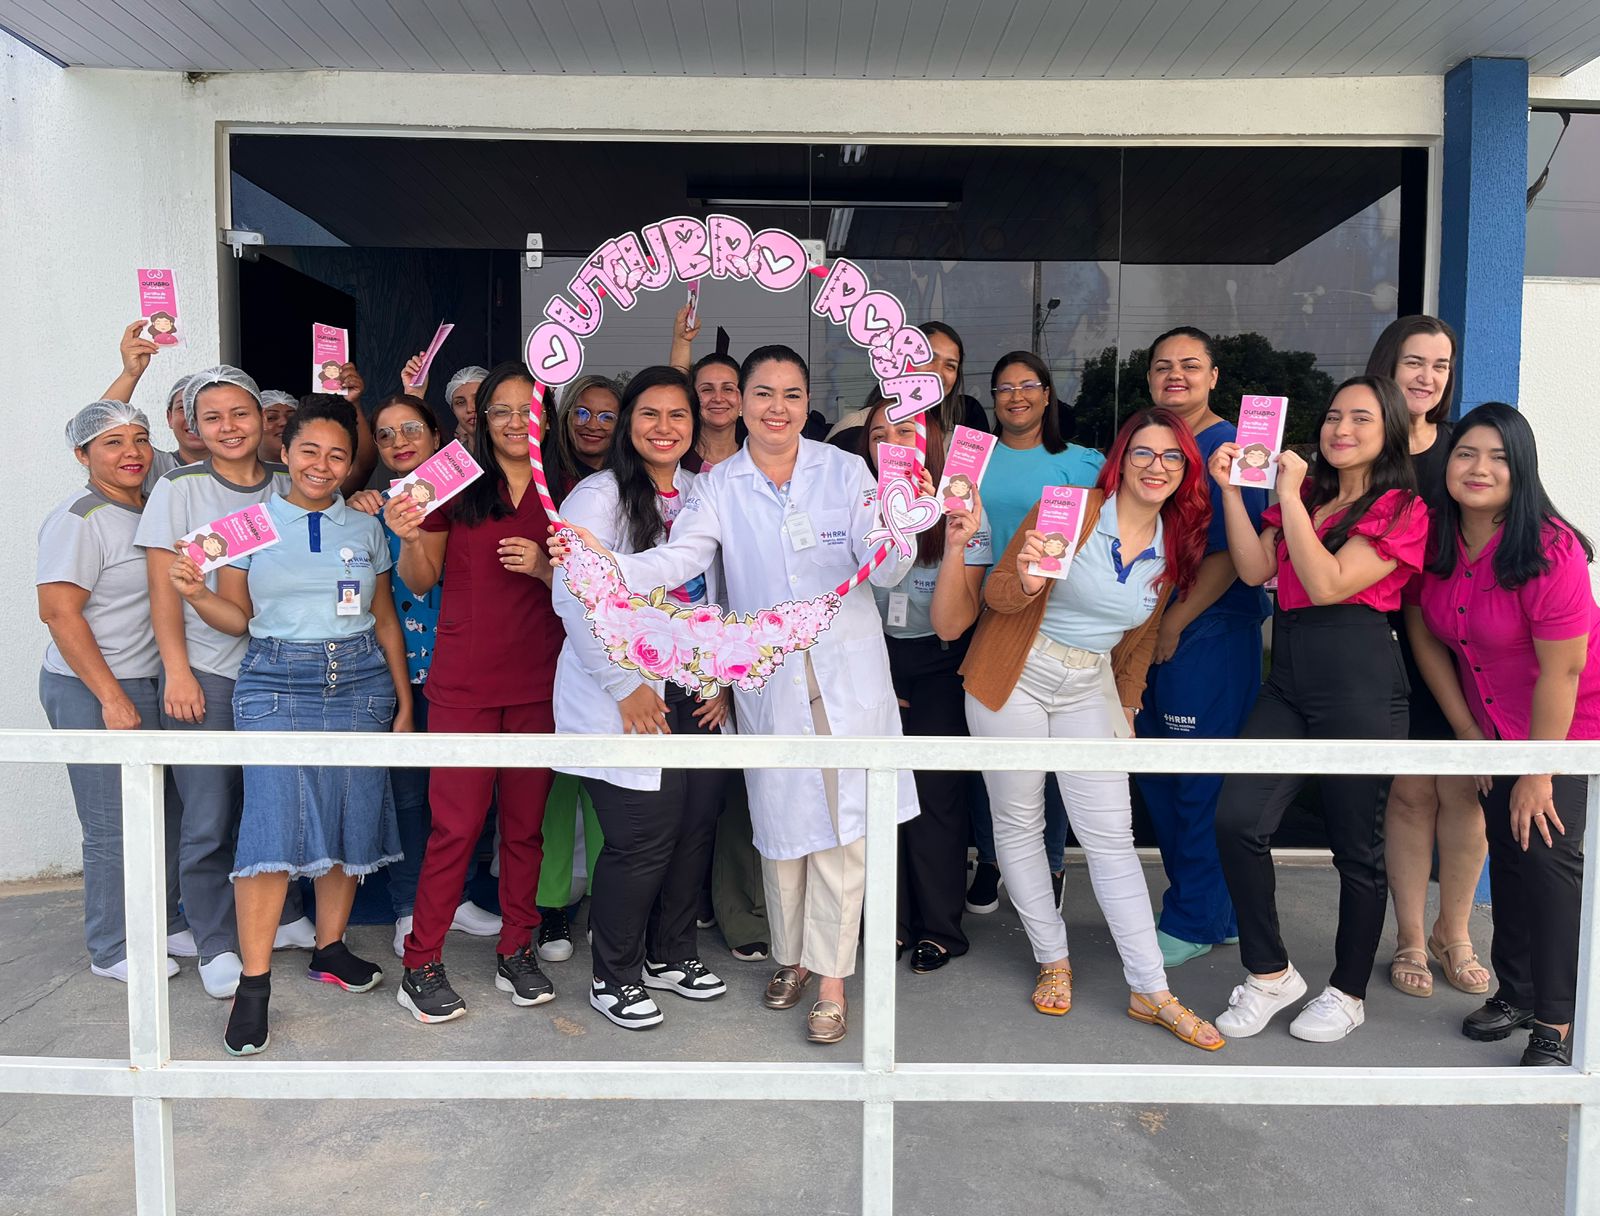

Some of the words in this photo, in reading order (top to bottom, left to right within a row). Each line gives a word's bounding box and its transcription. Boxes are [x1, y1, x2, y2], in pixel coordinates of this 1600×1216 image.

[524, 214, 809, 387] OUTUBRO
[811, 257, 944, 424] ROSA
[1243, 409, 1276, 417] OUTUBRO
[957, 439, 984, 451] OUTUBRO
[444, 451, 466, 478] OUTUBRO
[883, 459, 912, 468] OUTUBRO
[1044, 499, 1076, 507] OUTUBRO
[243, 512, 261, 541] OUTUBRO
